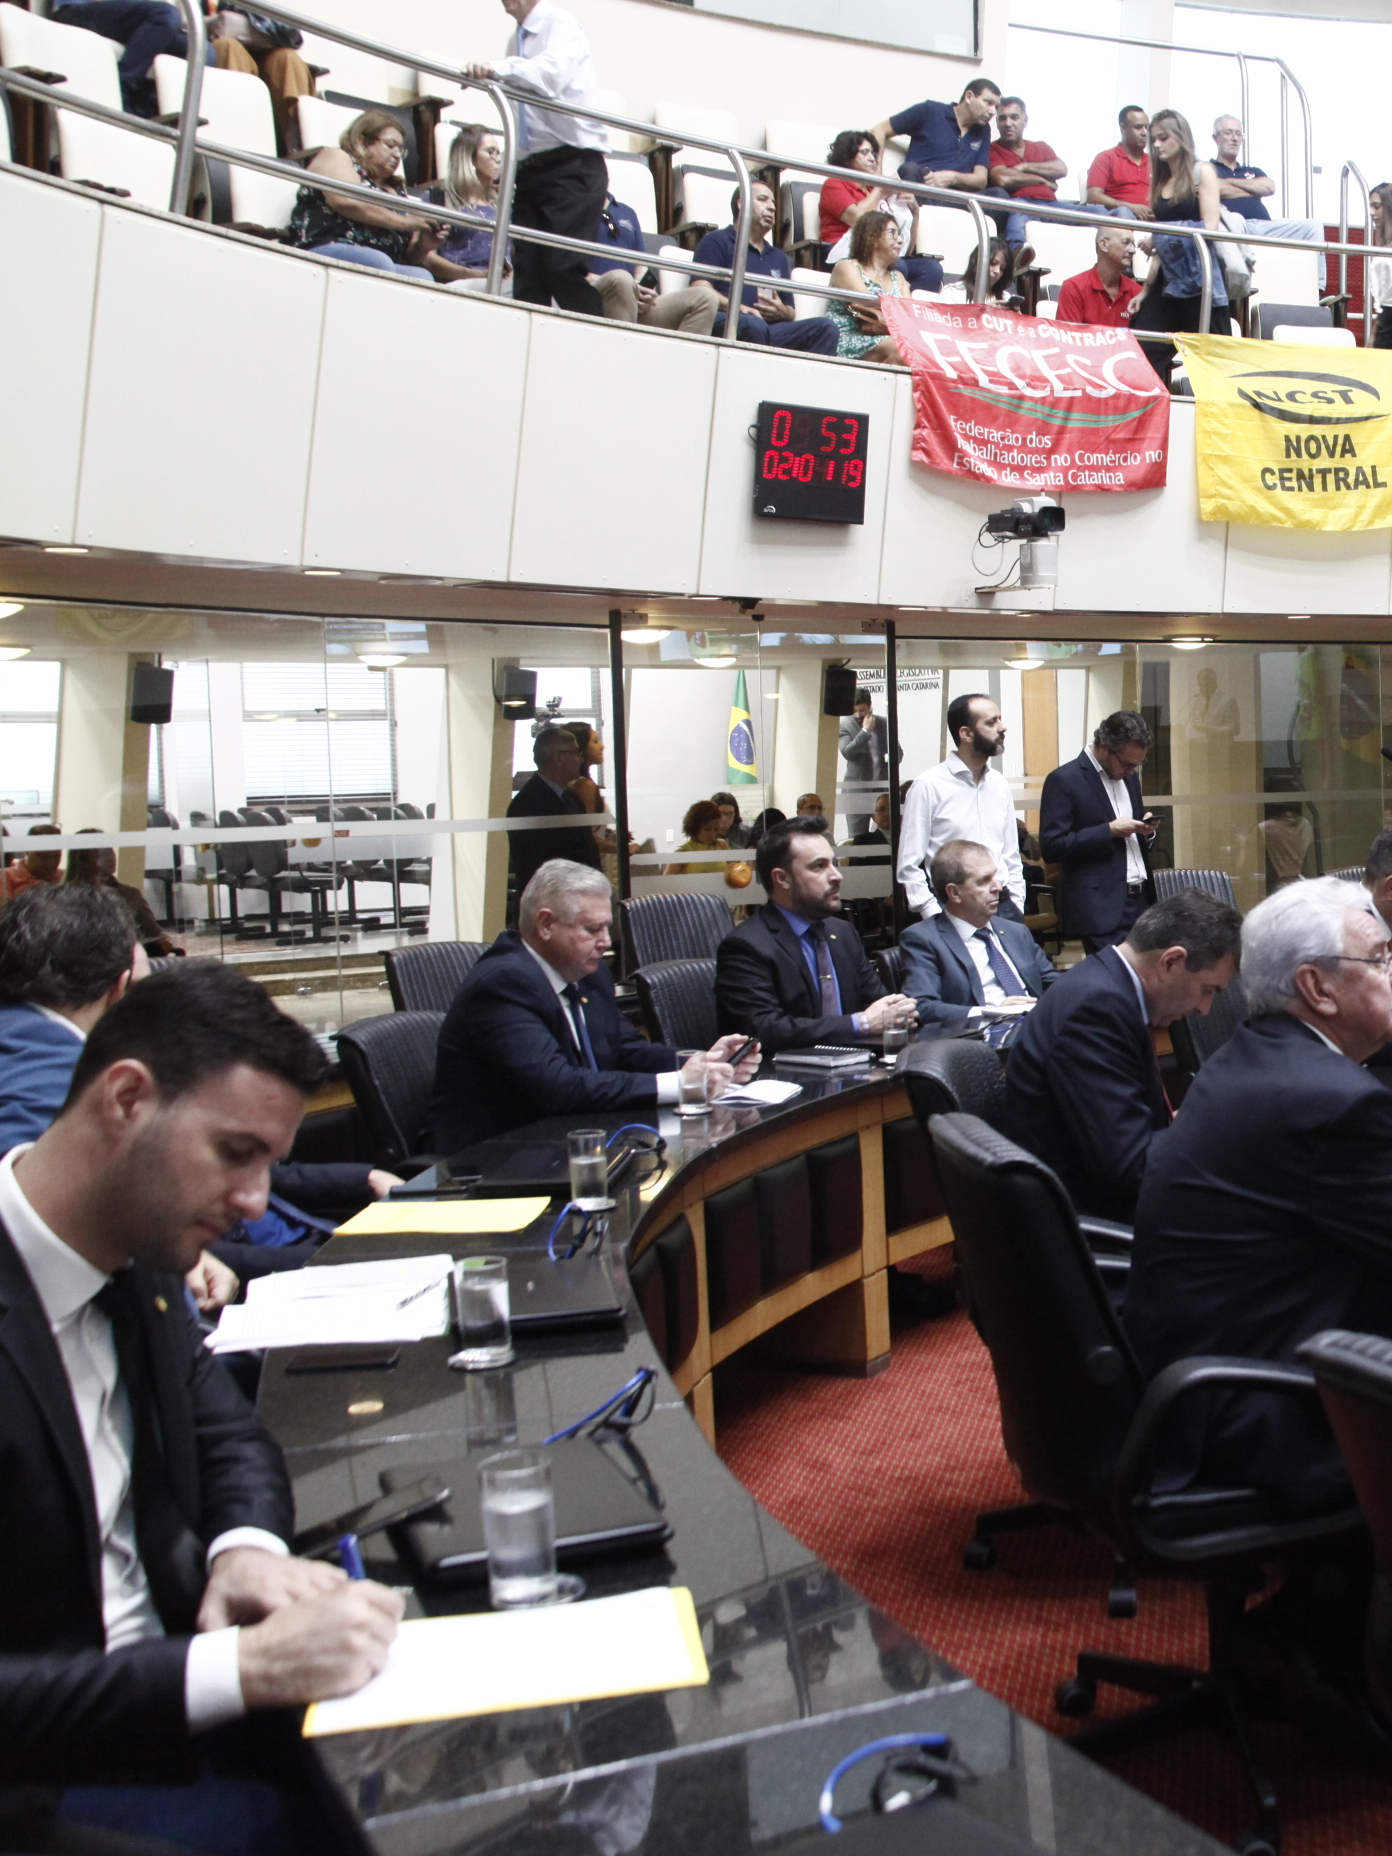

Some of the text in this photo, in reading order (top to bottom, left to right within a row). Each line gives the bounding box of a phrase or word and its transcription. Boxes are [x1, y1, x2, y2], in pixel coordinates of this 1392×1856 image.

[912, 303, 1128, 347] Filiada a CUT e a CONTRACS
[920, 330, 1162, 398] FECESC
[1251, 388, 1355, 405] NCST
[949, 414, 1053, 448] Federação dos
[1284, 433, 1358, 460] NOVA
[953, 431, 1163, 467] Trabalhadores no Comércio no
[953, 452, 1126, 486] Estado de Santa Catarina
[1260, 464, 1388, 493] CENTRAL
